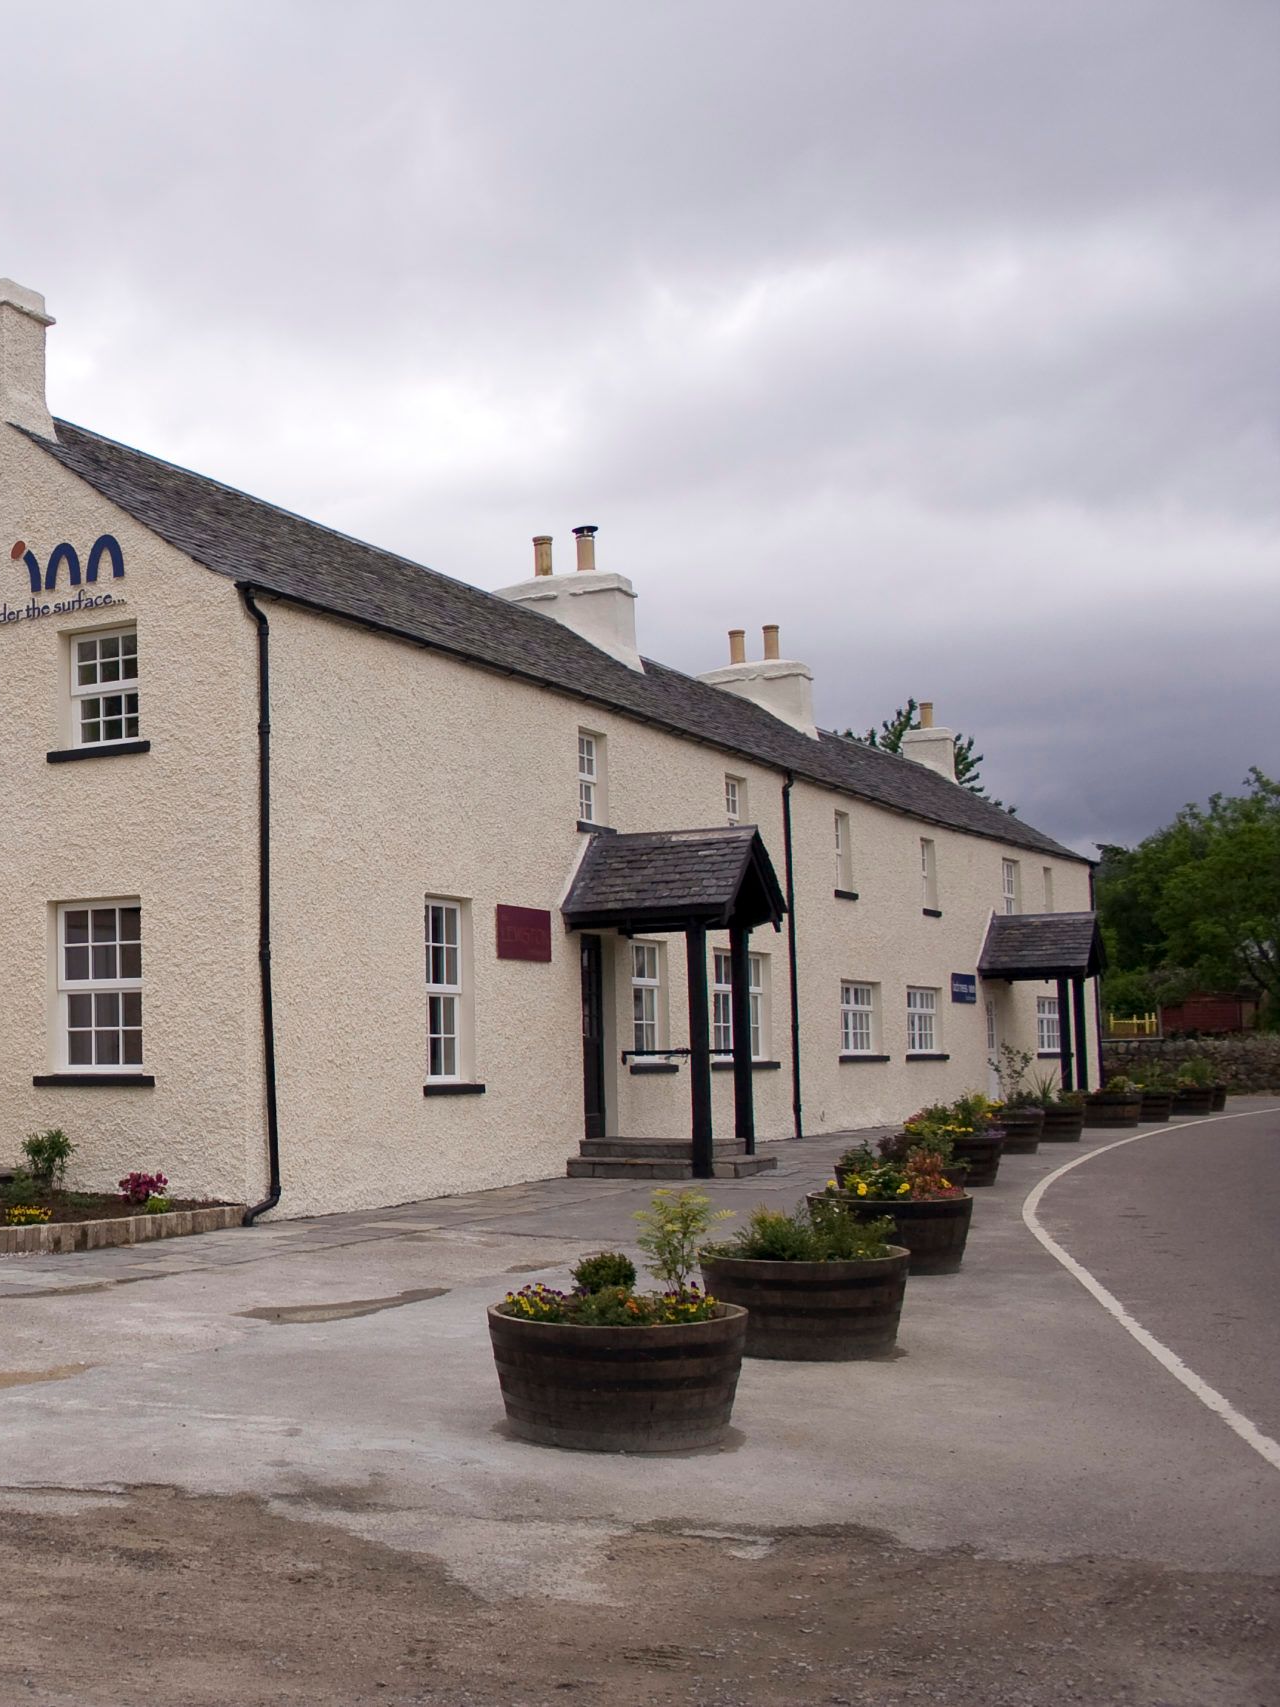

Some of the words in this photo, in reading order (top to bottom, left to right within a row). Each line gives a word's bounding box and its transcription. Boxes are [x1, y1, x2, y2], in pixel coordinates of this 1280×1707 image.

[11, 534, 125, 593] inn
[25, 598, 50, 618] the
[53, 588, 125, 614] surface...
